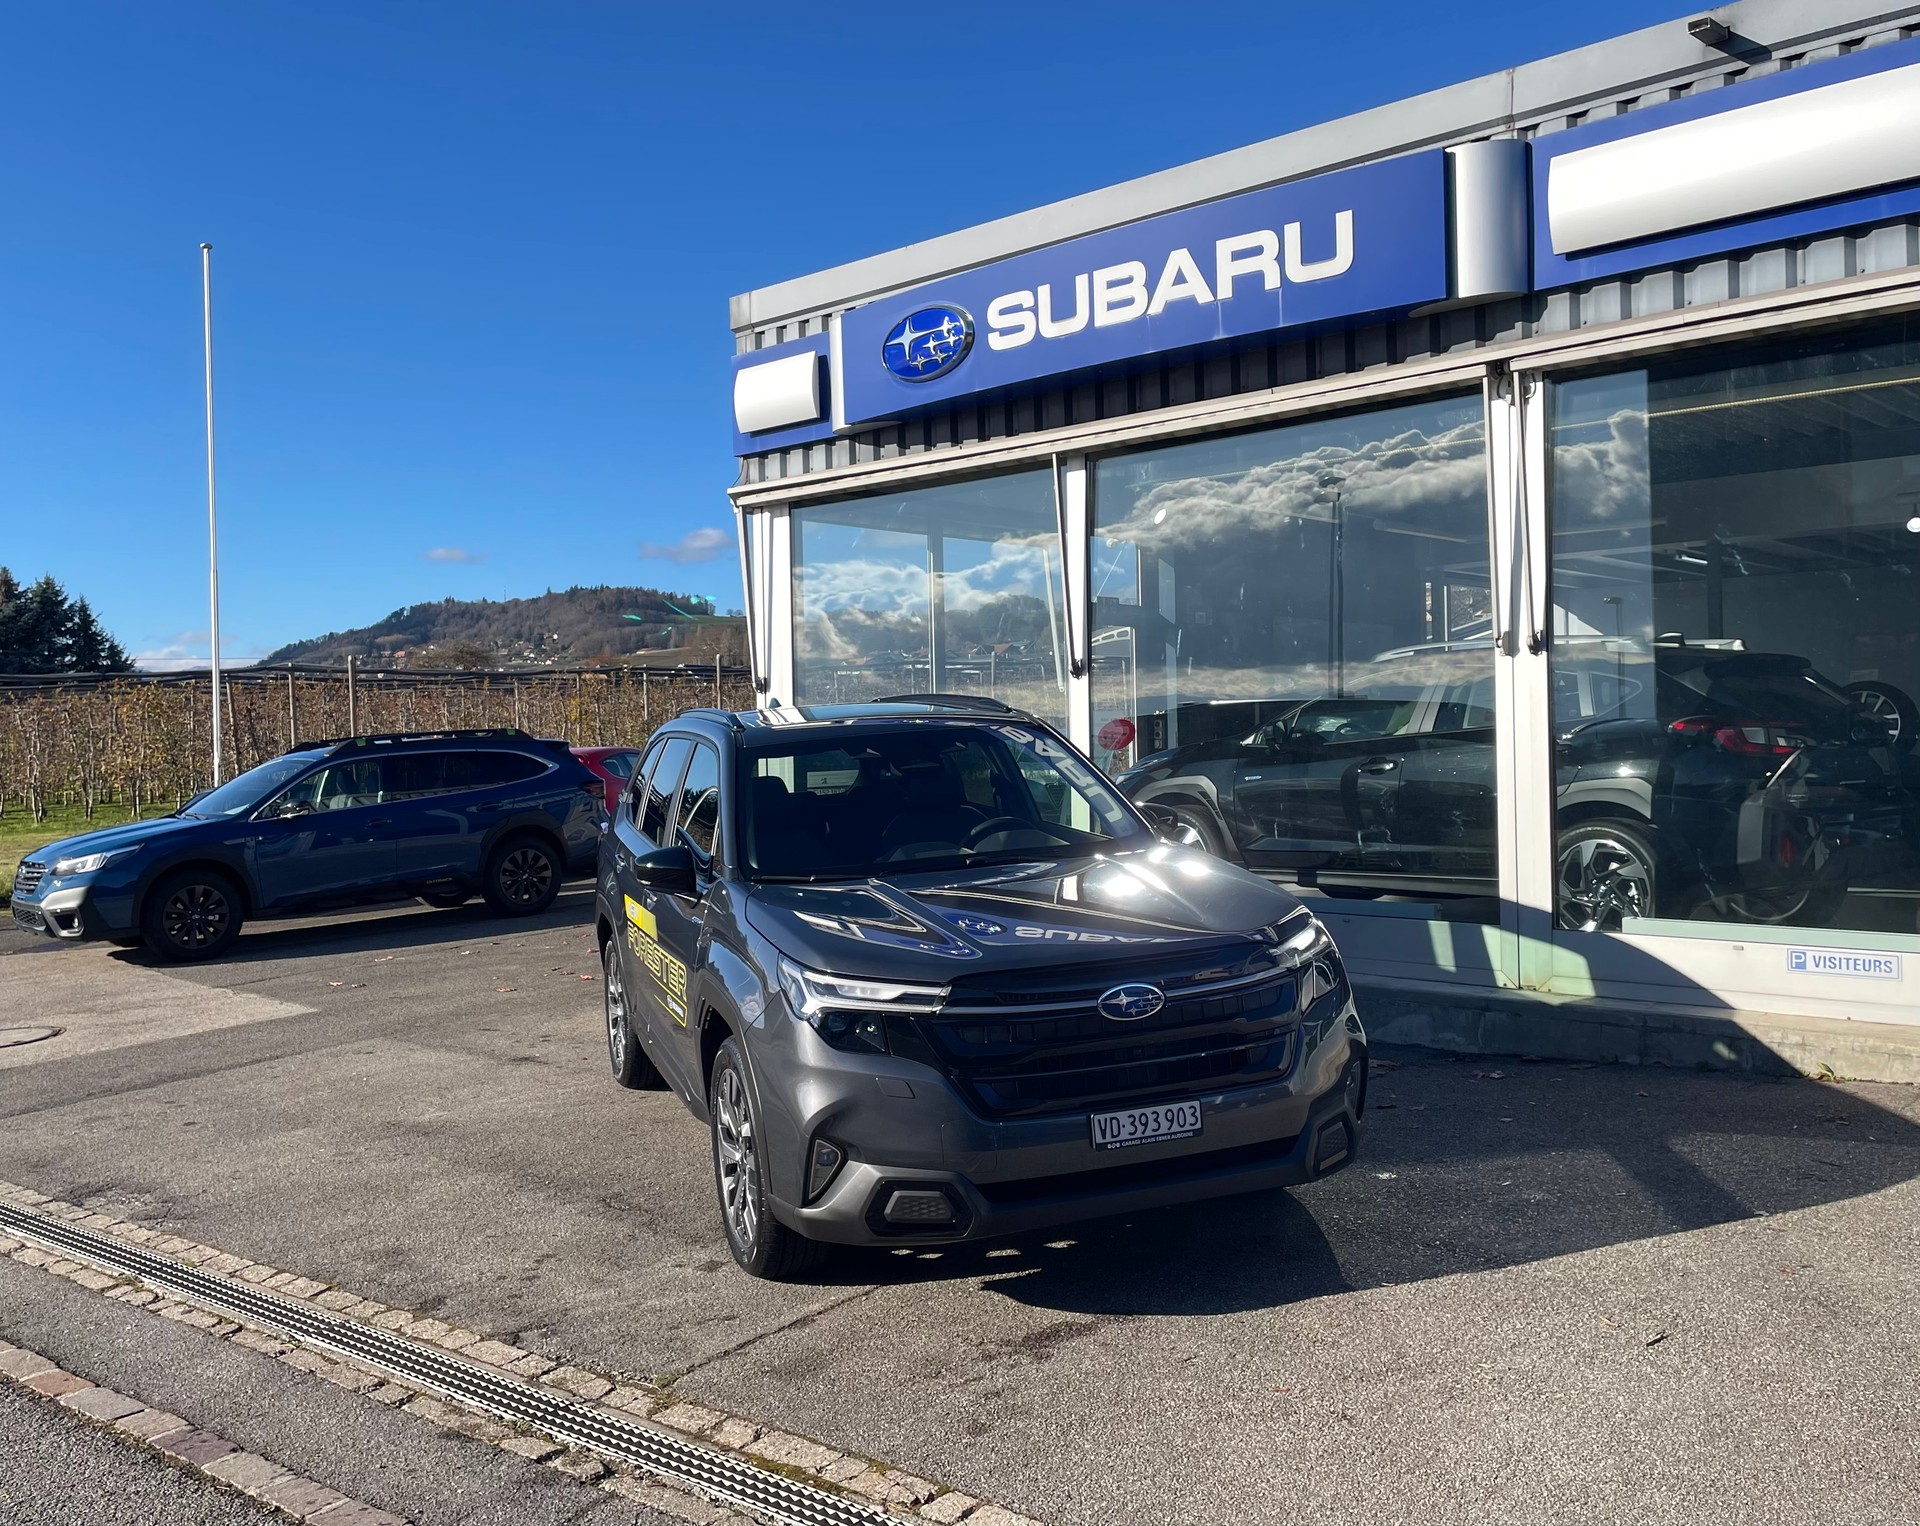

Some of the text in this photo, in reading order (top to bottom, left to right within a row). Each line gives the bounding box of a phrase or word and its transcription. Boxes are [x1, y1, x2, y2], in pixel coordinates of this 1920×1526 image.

[986, 209, 1355, 352] SUBARU
[627, 921, 687, 1002] FORESTER
[1812, 955, 1893, 974] VISITEURS
